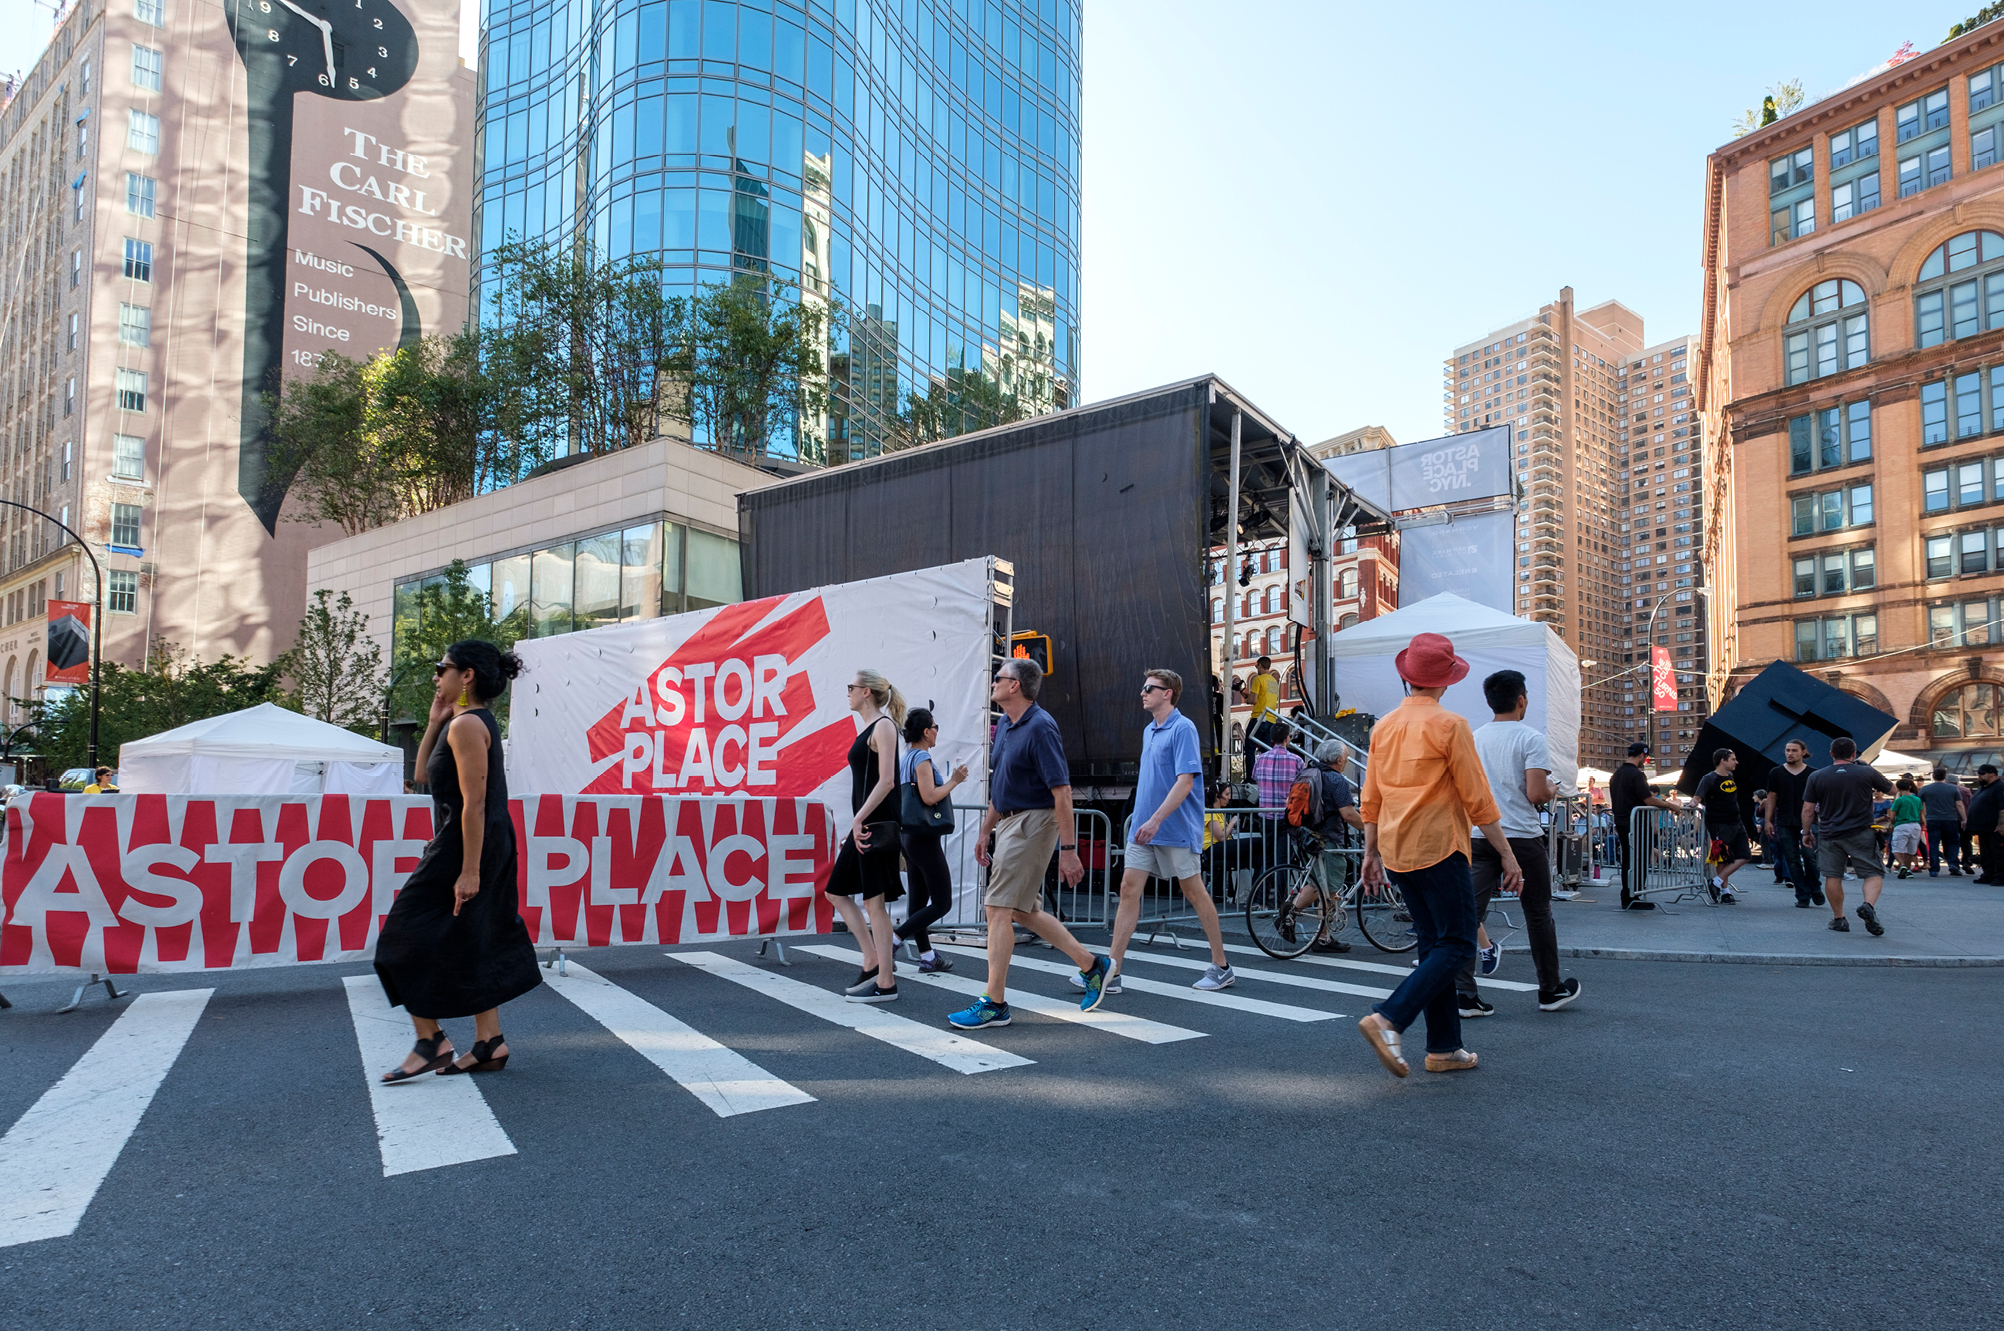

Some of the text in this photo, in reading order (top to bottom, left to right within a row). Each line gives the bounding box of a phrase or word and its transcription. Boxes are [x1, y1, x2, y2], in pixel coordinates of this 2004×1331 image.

[260, 1, 272, 14] 9
[268, 29, 280, 43] 8
[373, 18, 384, 30] 2
[287, 54, 298, 67] 7
[378, 46, 388, 58] 3
[318, 74, 329, 86] 6
[349, 77, 360, 90] 5
[367, 67, 378, 78] 4
[344, 127, 431, 179] THE
[330, 162, 436, 216] CARL
[298, 185, 467, 260] FISCHER
[295, 249, 354, 278] Music
[294, 282, 397, 320] Publishers
[293, 315, 350, 342] Since
[620, 653, 788, 729] ASTOR
[1653, 675, 1678, 700] TURNS
[1654, 687, 1666, 699] 50
[622, 721, 779, 789] PLACE
[525, 833, 815, 906] PLACE
